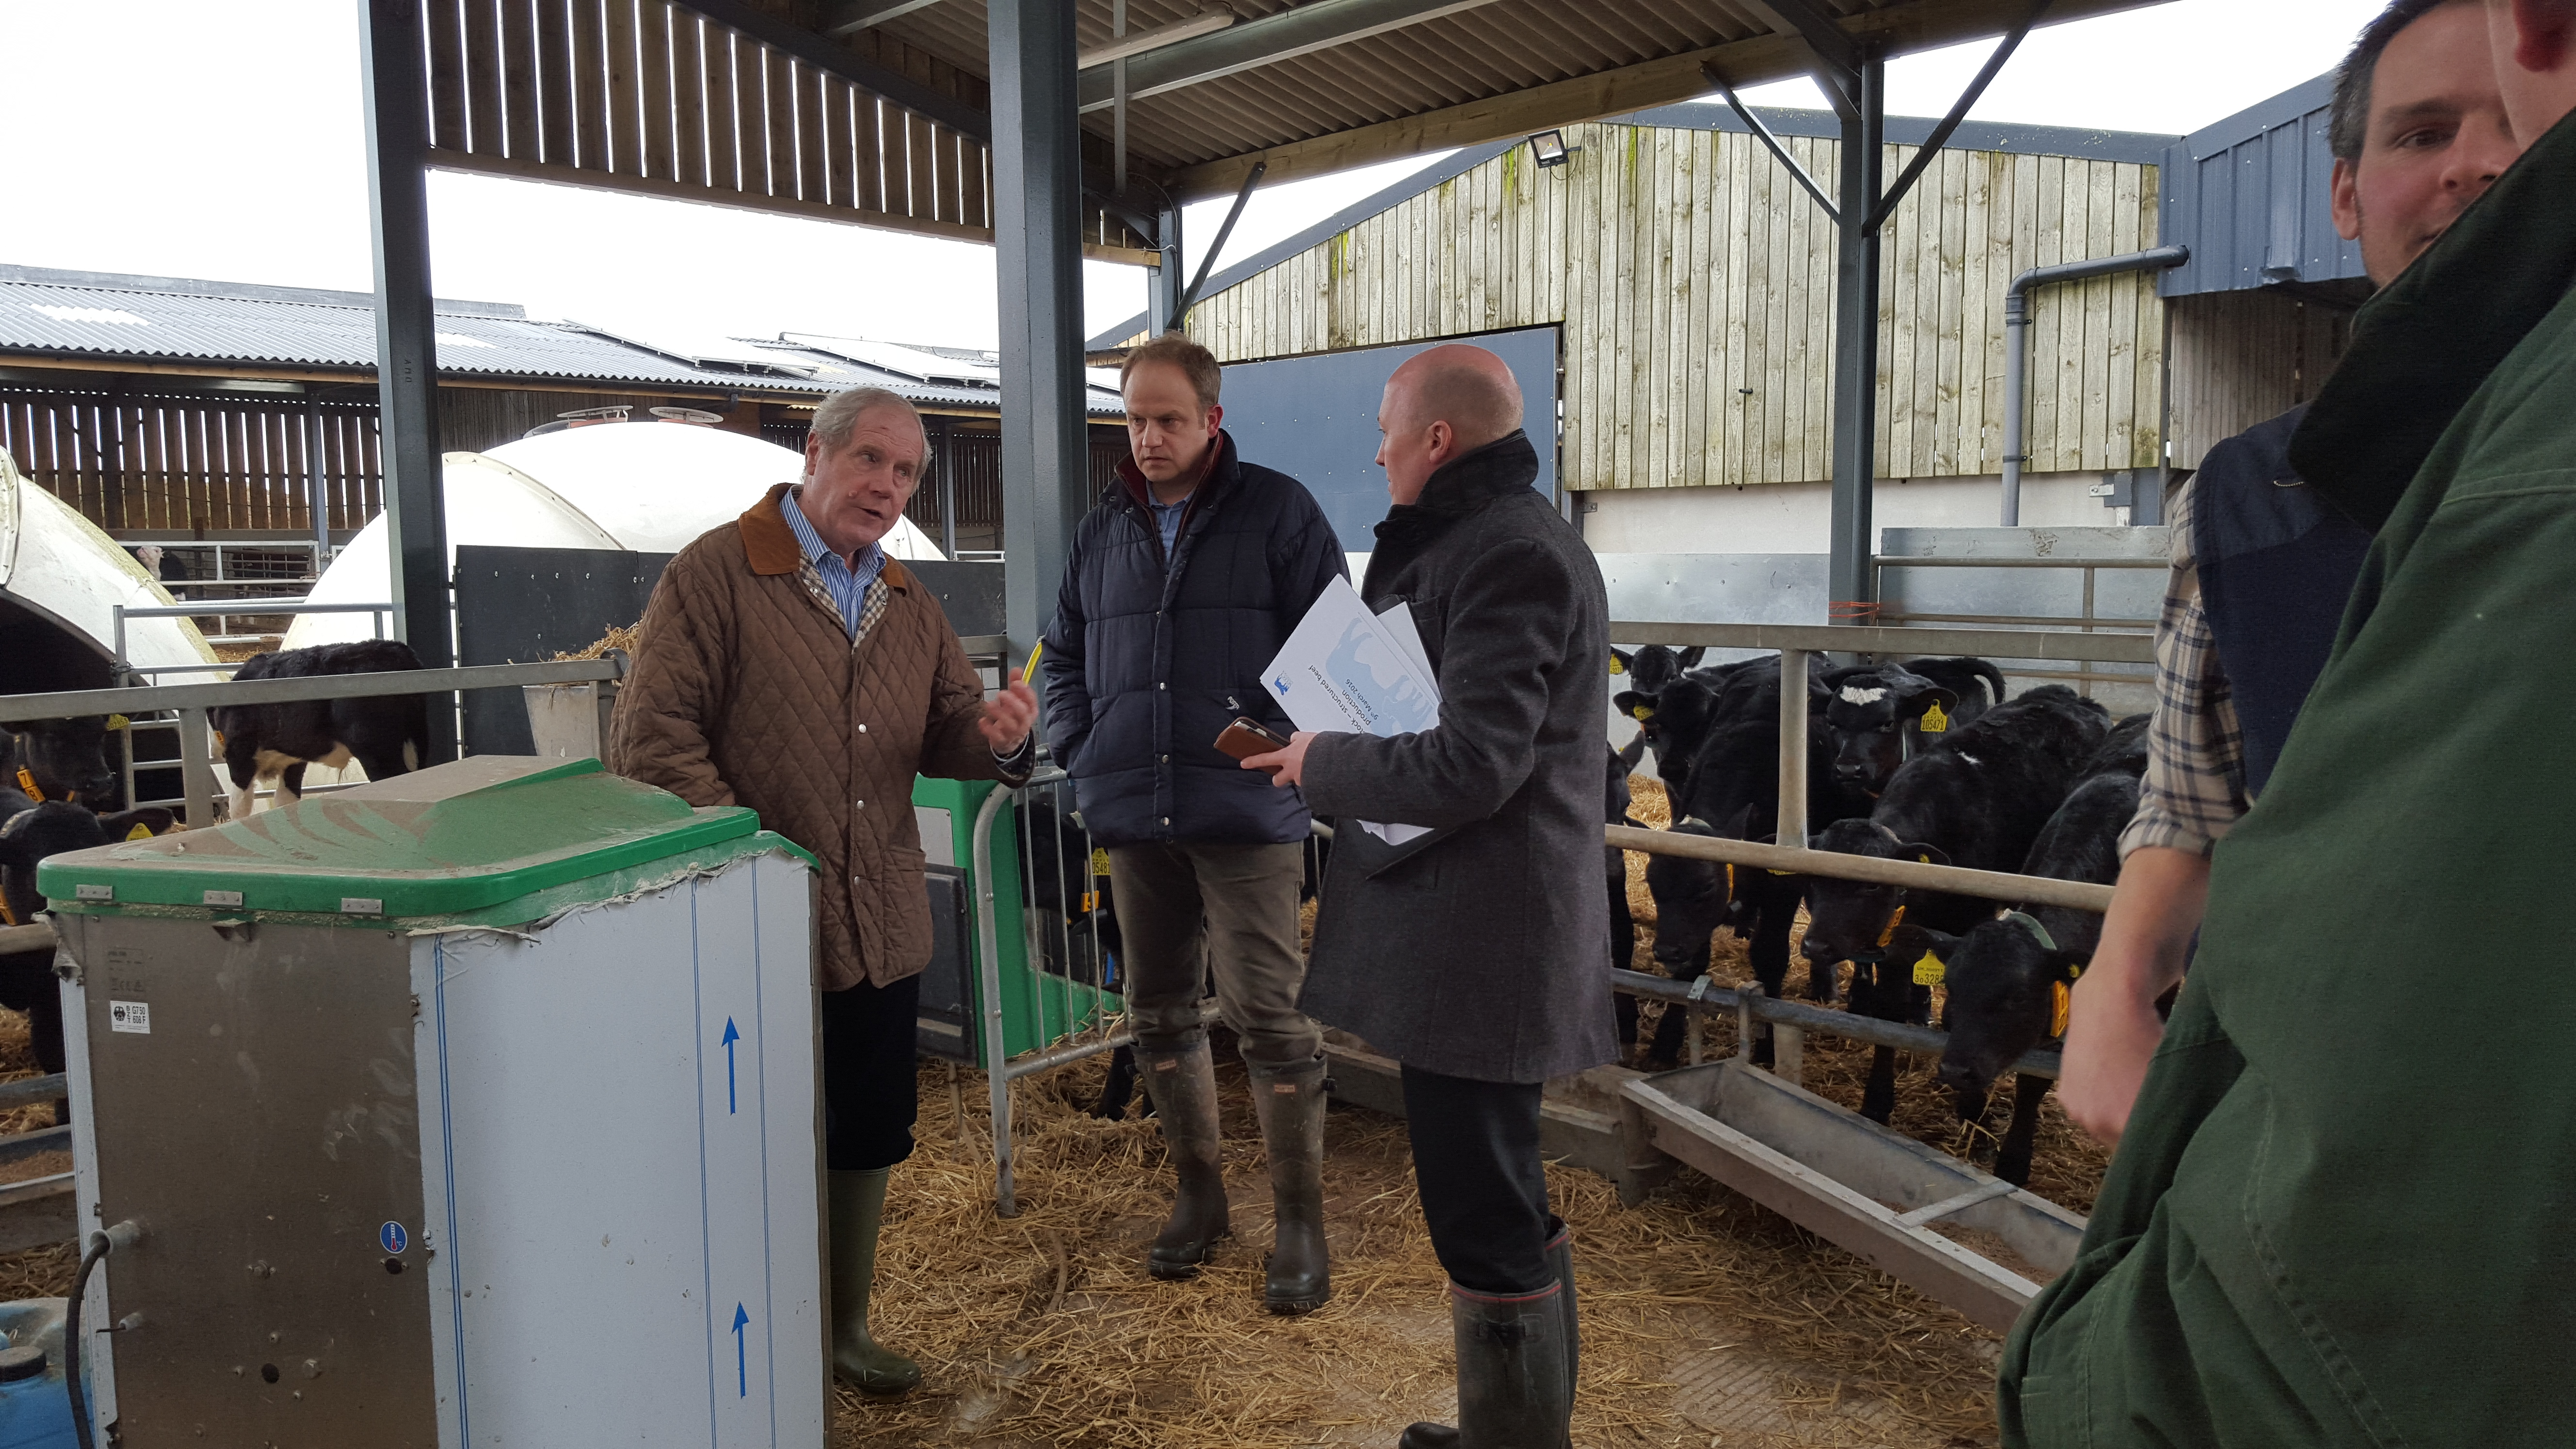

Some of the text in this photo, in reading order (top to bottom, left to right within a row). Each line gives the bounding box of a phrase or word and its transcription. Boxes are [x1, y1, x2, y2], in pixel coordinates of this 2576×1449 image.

[1308, 665, 1322, 681] beef
[1345, 679, 1358, 694] 2016
[1320, 679, 1348, 713] structured
[1357, 692, 1372, 712] March
[1342, 690, 1372, 726] production
[1921, 719, 1944, 731] 105471
[20, 773, 28, 785] 7
[29, 790, 38, 802] 8
